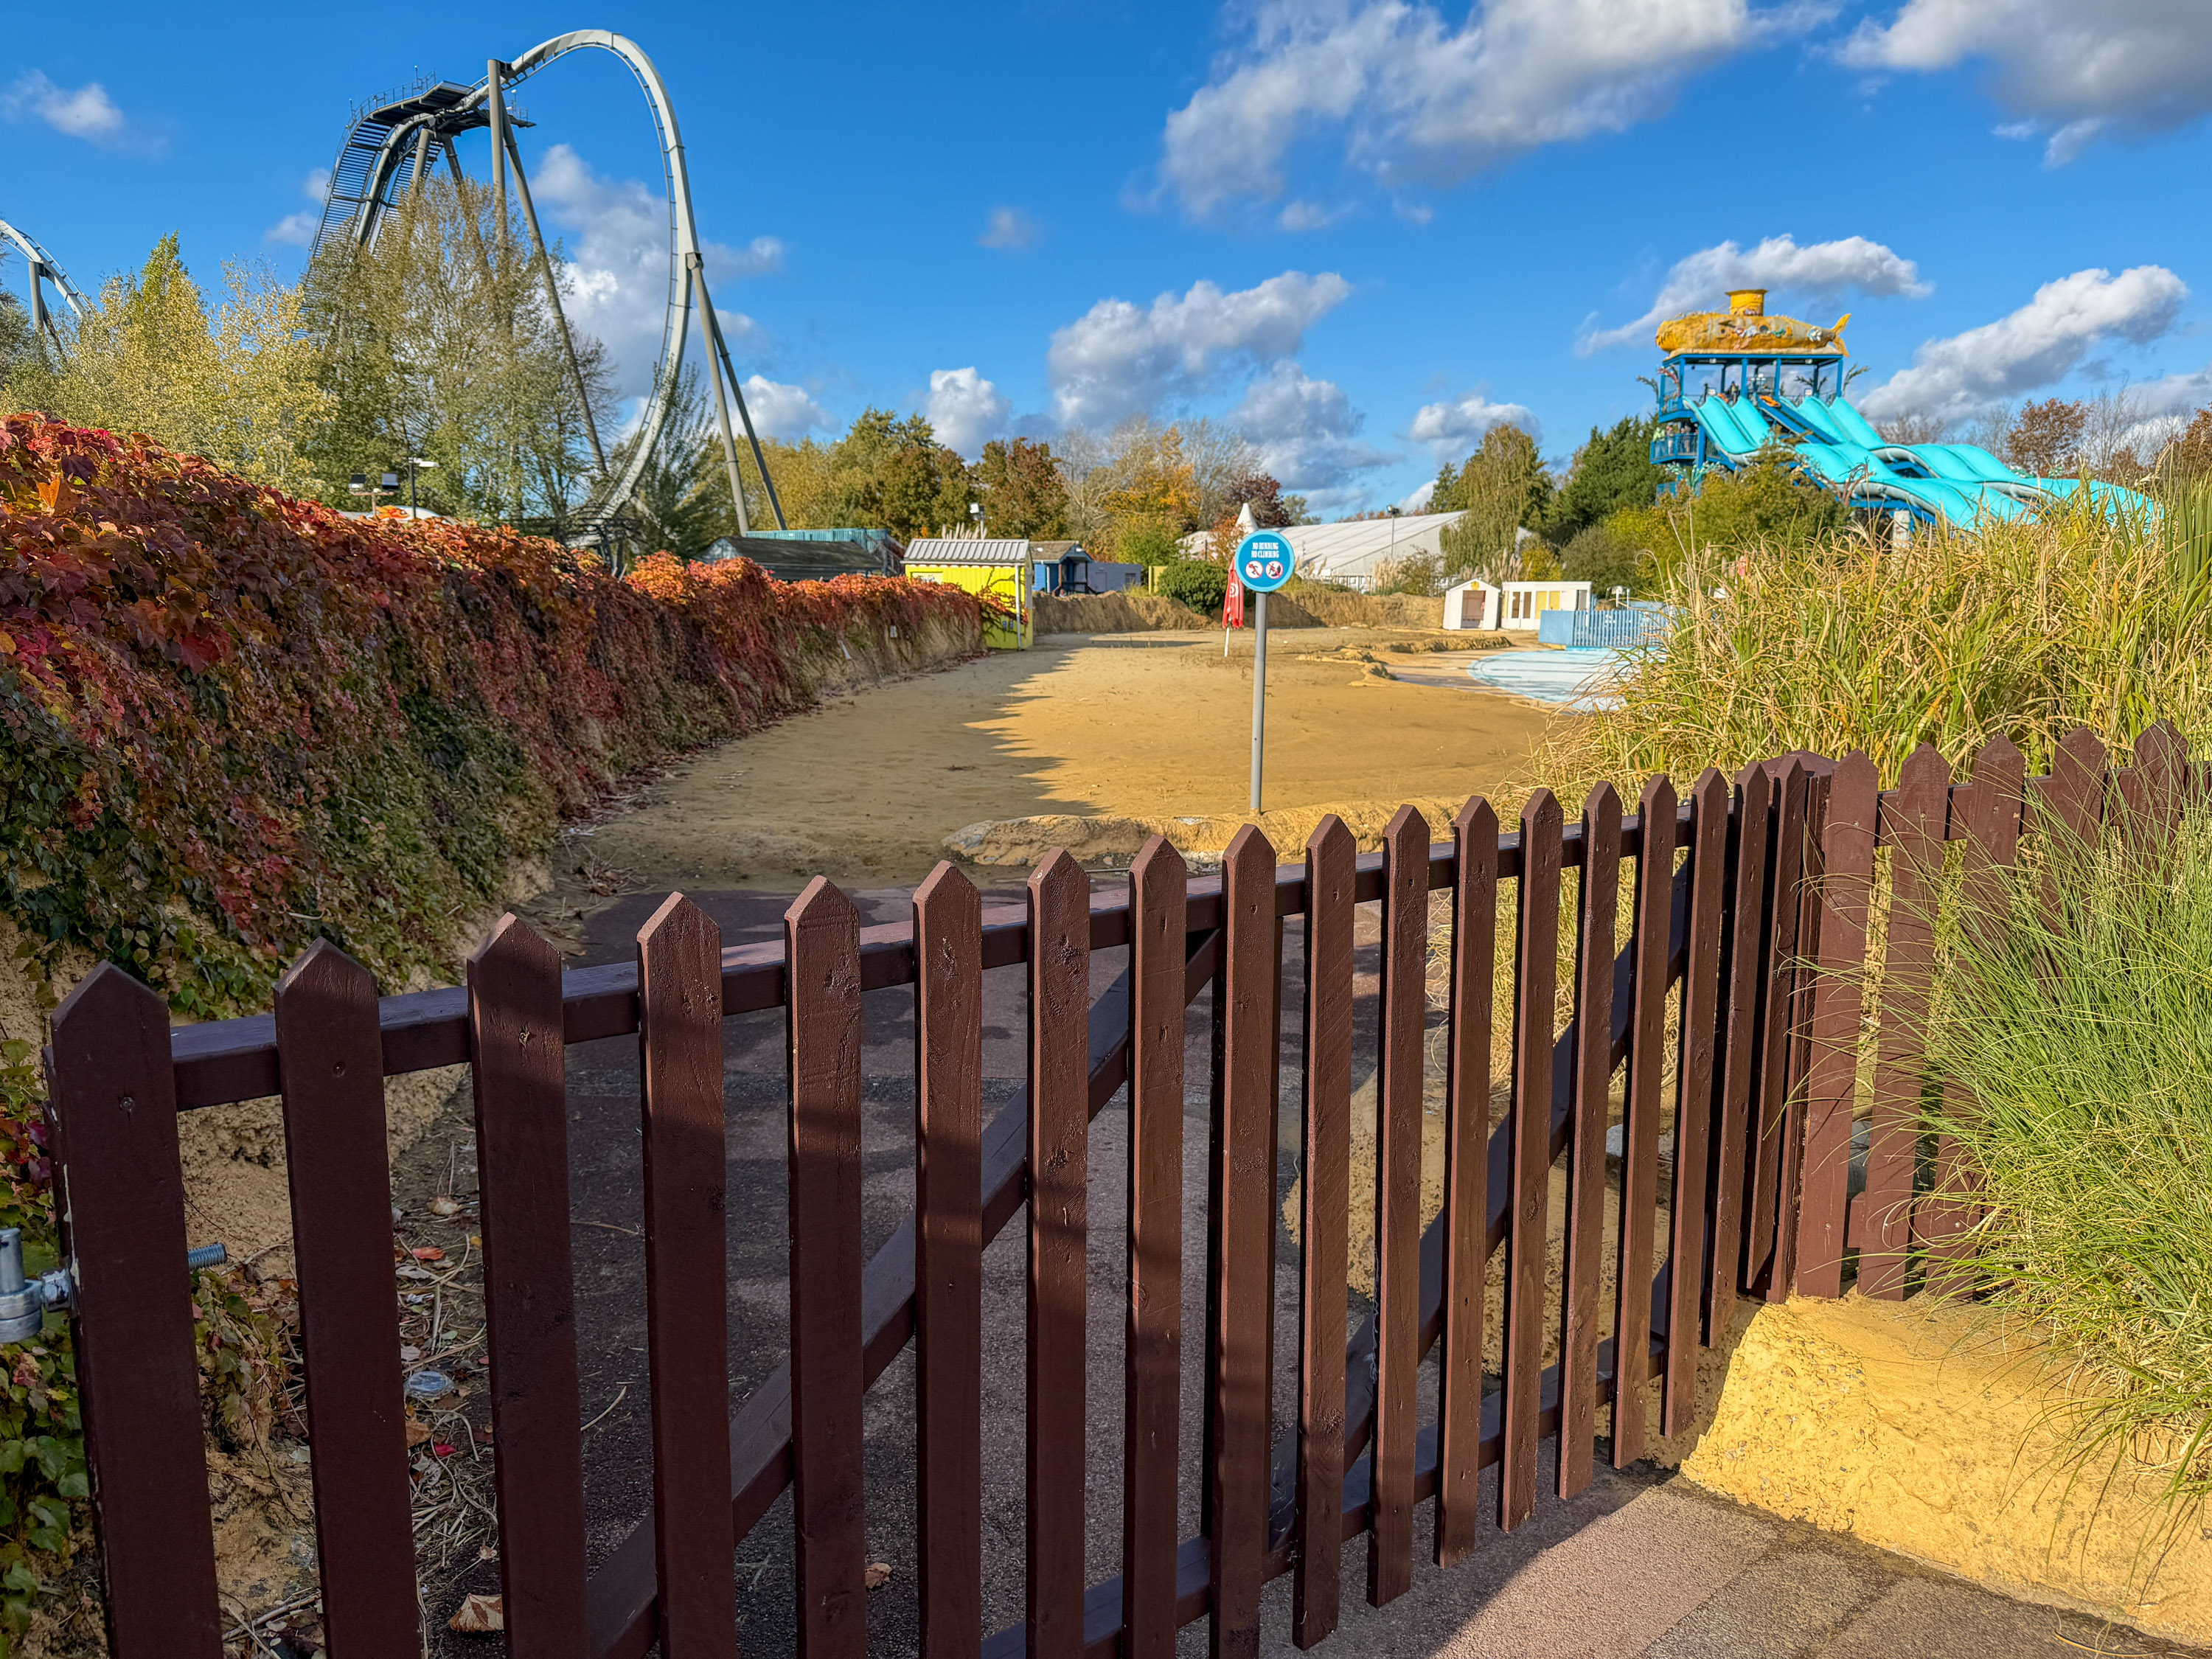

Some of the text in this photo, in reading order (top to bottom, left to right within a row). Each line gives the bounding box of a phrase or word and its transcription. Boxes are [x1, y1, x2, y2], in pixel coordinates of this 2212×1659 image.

[1252, 542, 1279, 550] NO RUNNING
[1251, 550, 1279, 558] NO CLIMBING
